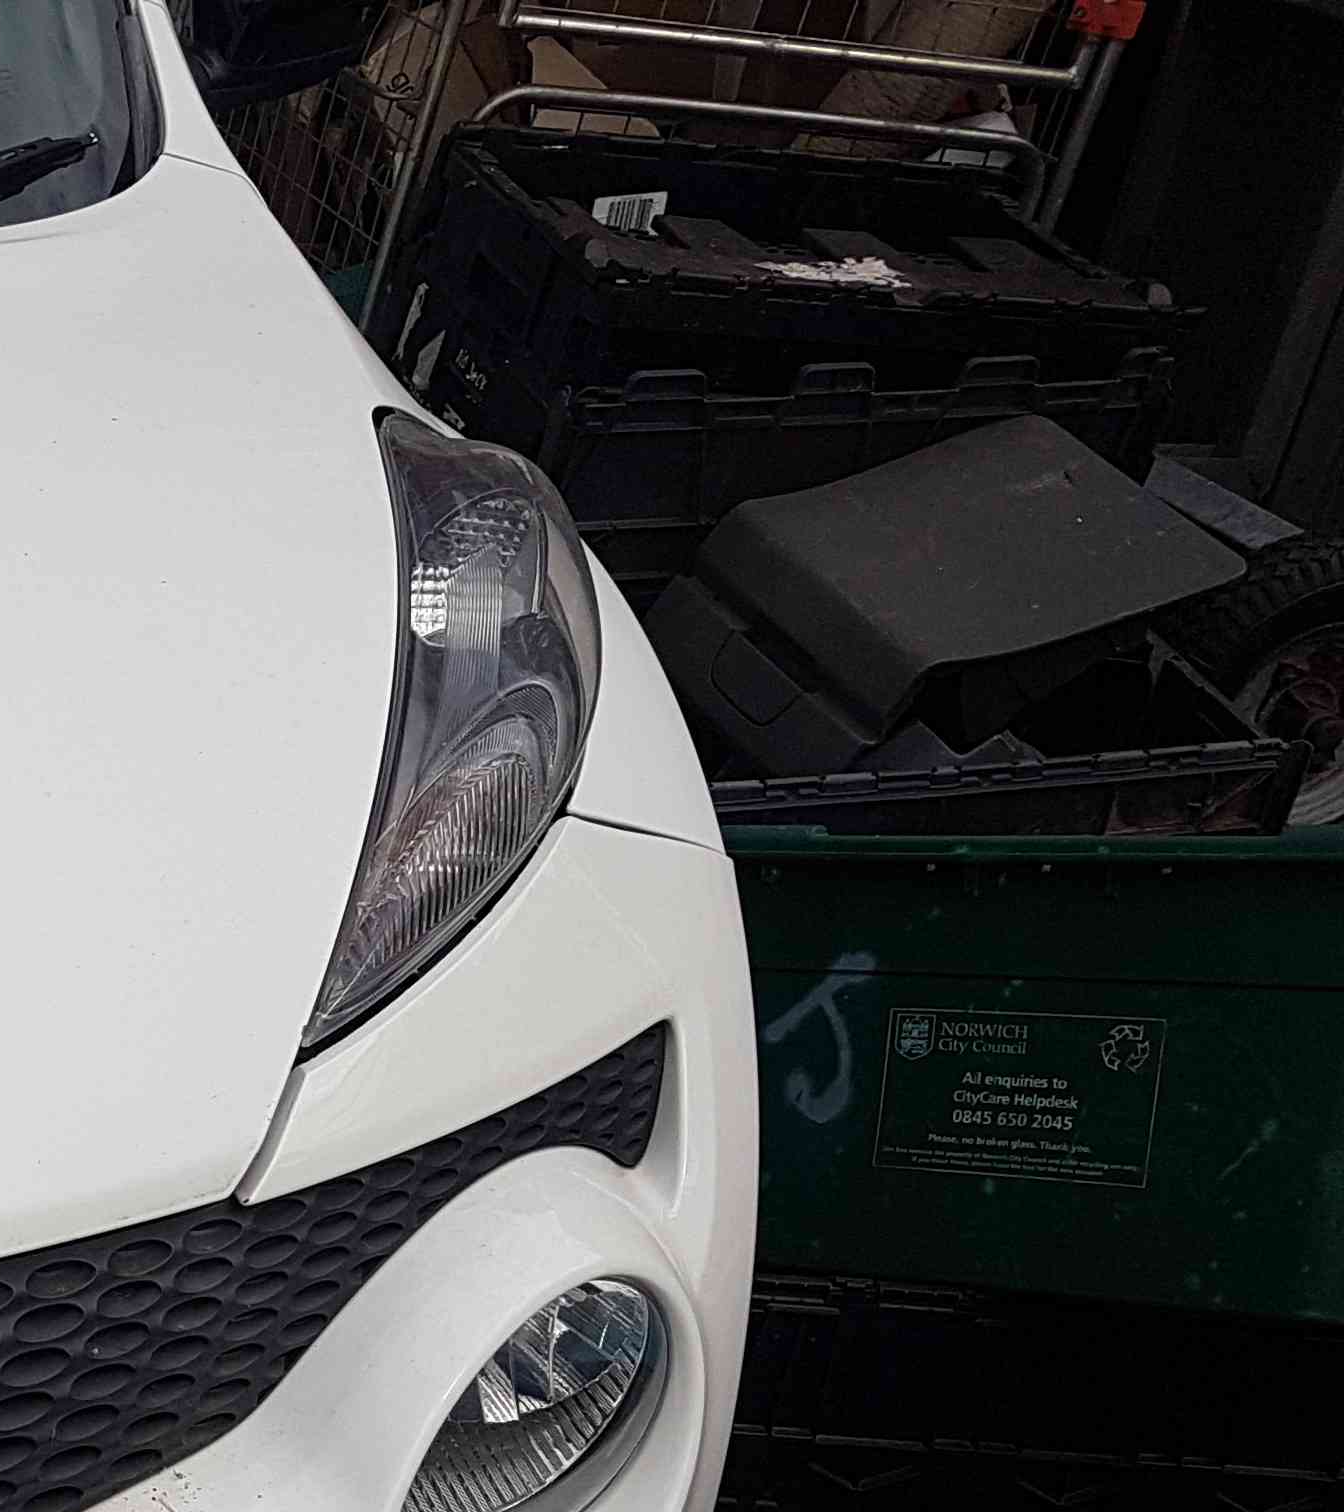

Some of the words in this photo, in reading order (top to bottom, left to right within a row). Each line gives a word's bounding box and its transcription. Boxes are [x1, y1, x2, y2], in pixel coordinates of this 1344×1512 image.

[941, 1022, 1029, 1039] NORWICH
[938, 1038, 968, 1055] City
[972, 1040, 1027, 1055] Council
[962, 1072, 982, 1085] All
[985, 1074, 1048, 1089] enquiries
[1052, 1077, 1068, 1089] to
[953, 1089, 1010, 1106] CityCare
[1014, 1093, 1080, 1111] Helpdesk
[952, 1109, 993, 1125] 0845
[997, 1112, 1028, 1127] 650
[1031, 1114, 1073, 1131] 2045
